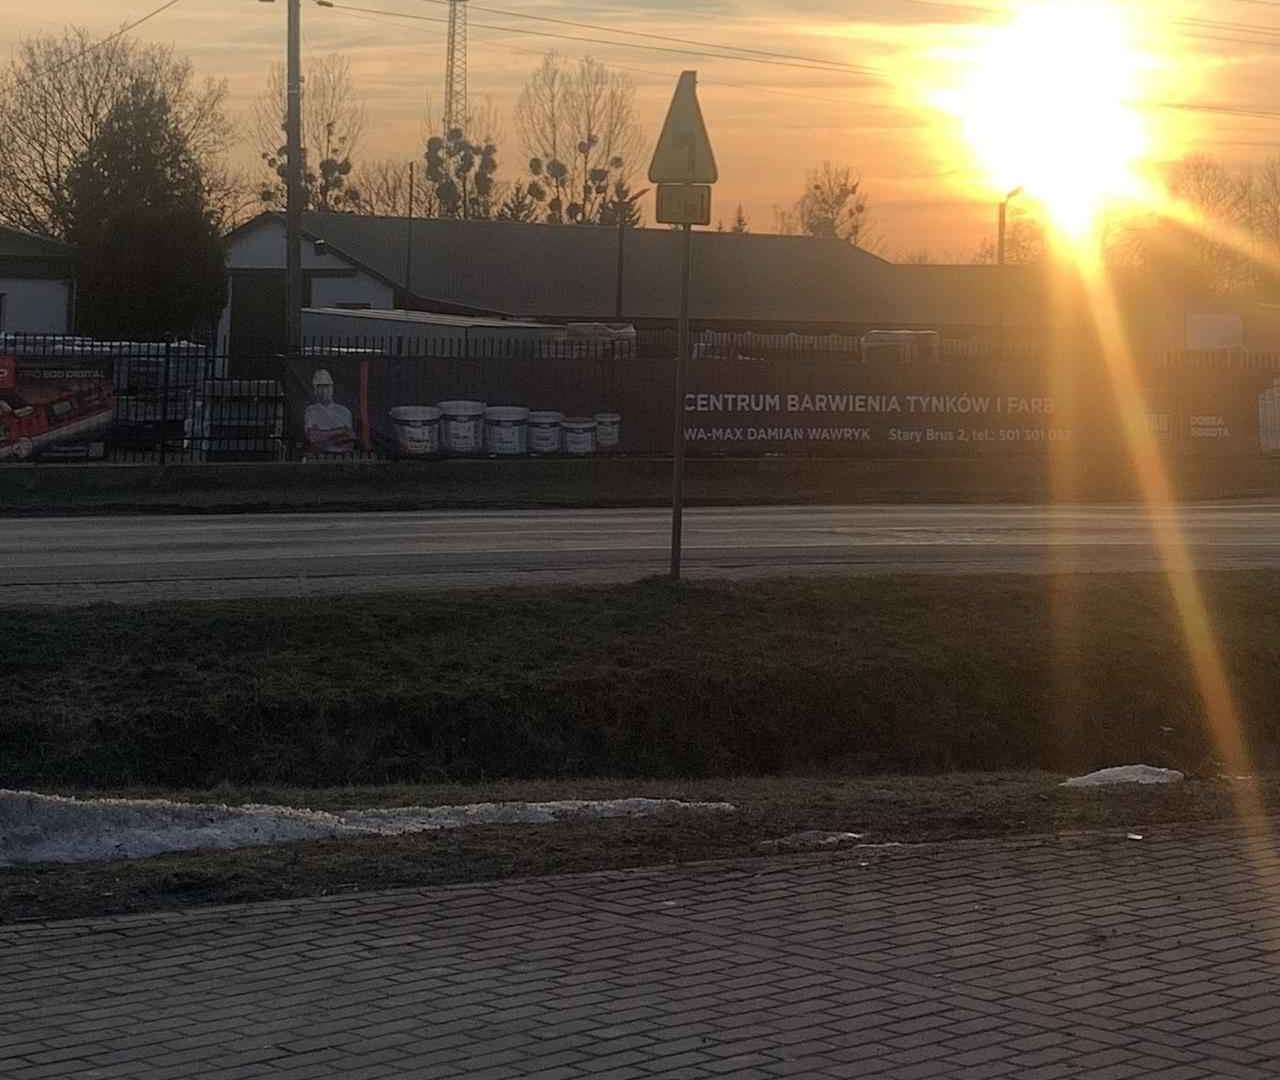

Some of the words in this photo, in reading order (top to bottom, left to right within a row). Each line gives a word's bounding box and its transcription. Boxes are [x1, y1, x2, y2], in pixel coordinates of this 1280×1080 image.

[65, 369, 106, 379] DIGITAL
[684, 394, 780, 412] CENTRUM
[787, 394, 901, 413] BARWIENIA
[906, 392, 990, 414] TYNKÓW
[1007, 396, 1055, 414] FARB
[1190, 416, 1224, 426] DOBRA
[683, 428, 743, 441] WA-MAX
[747, 428, 803, 441] DAMIAN
[808, 428, 870, 441] WAWRYK
[888, 428, 922, 443] Stary
[927, 428, 954, 442] Brus
[998, 429, 1020, 442] 501
[1023, 429, 1044, 442] 301
[1190, 427, 1230, 438] ROBOTA
